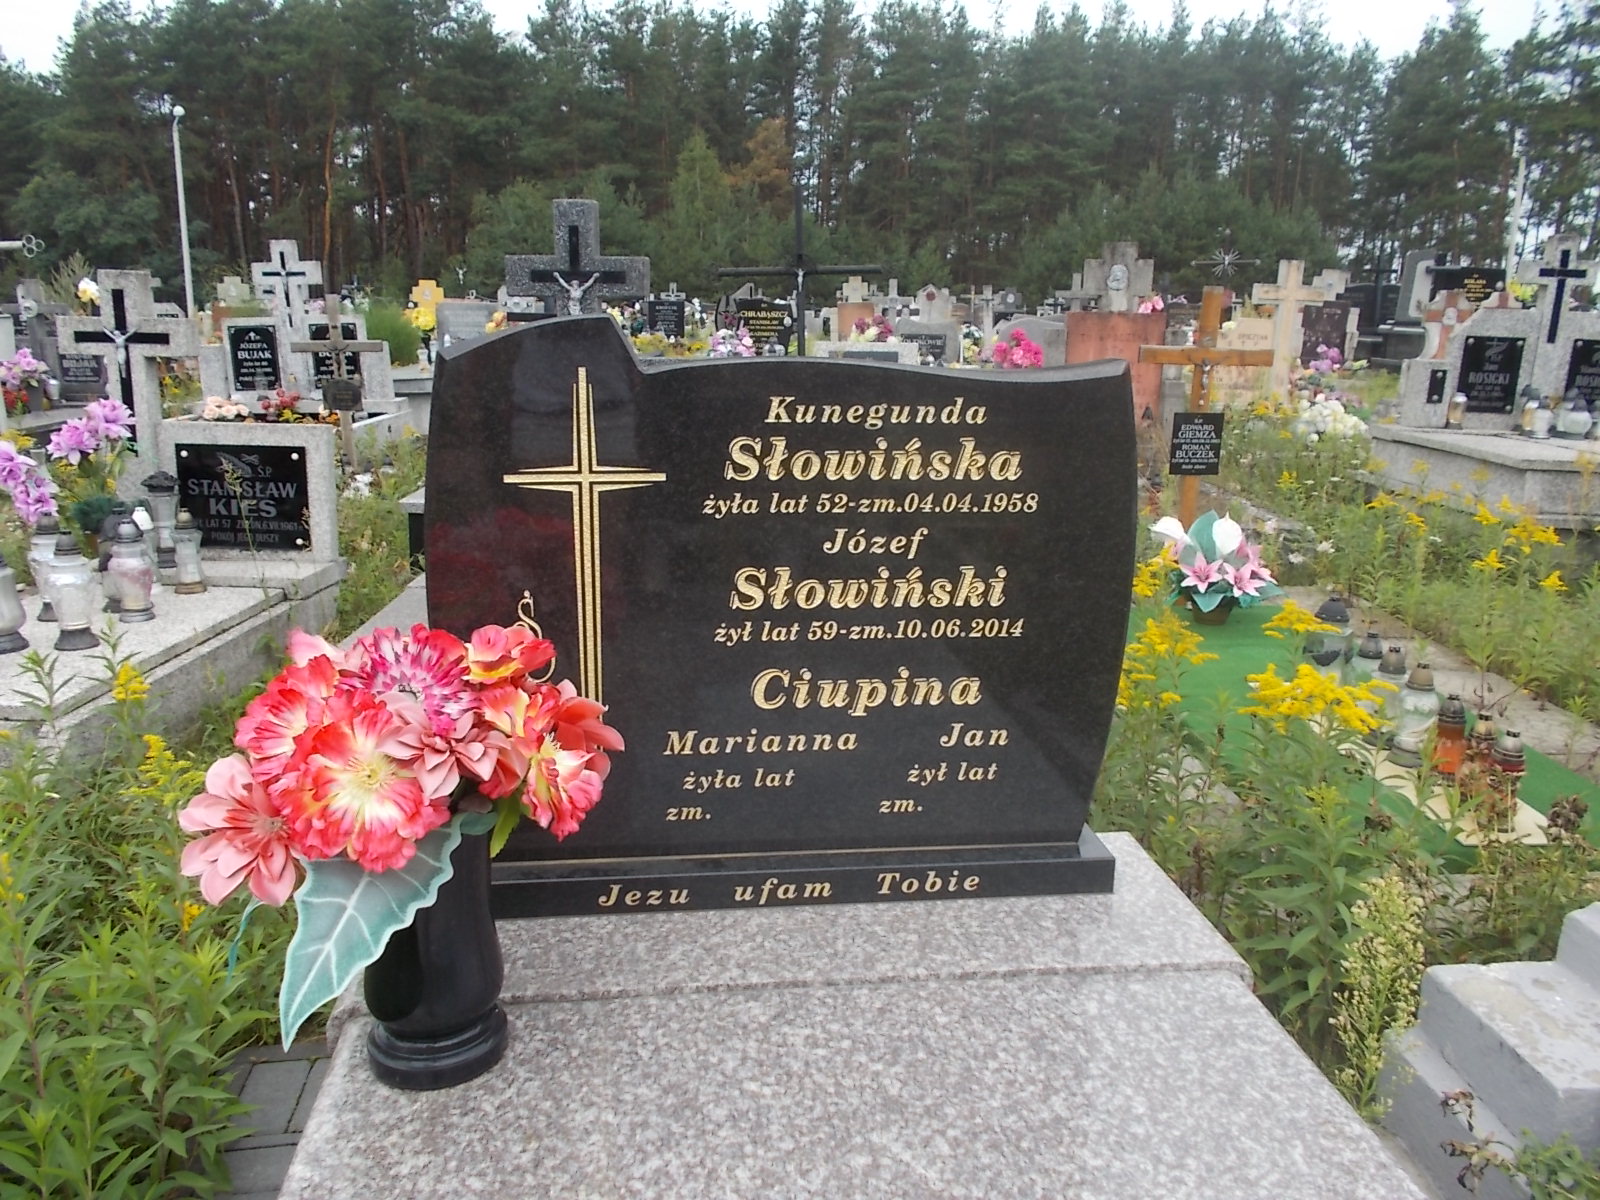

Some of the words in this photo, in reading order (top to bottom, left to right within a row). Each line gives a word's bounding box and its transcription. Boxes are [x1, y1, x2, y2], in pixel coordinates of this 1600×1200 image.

[237, 350, 272, 359] BUJAK
[764, 396, 988, 430] Kunegunda
[1178, 430, 1216, 439] GIEMZA
[723, 436, 1024, 482] Słowińska
[1175, 450, 1215, 458] BUCZEK
[187, 478, 297, 499] STANSŁAW
[702, 493, 759, 519] żyła
[769, 493, 808, 514] lat
[822, 528, 929, 559] Józef
[729, 565, 1008, 610] Słowiński
[714, 621, 753, 646] żył
[761, 621, 800, 642] lat
[751, 666, 983, 717] Ciupina
[663, 728, 858, 755] Marianna
[939, 723, 1010, 747] Jan
[682, 769, 743, 794] żyła
[754, 767, 796, 788] lat
[907, 762, 948, 784] żył
[957, 761, 998, 782] lat
[666, 804, 712, 821] zm.
[878, 797, 923, 814] zm.
[598, 883, 690, 907] Jezu
[734, 876, 833, 905] ufam
[877, 869, 982, 895] Tobie
